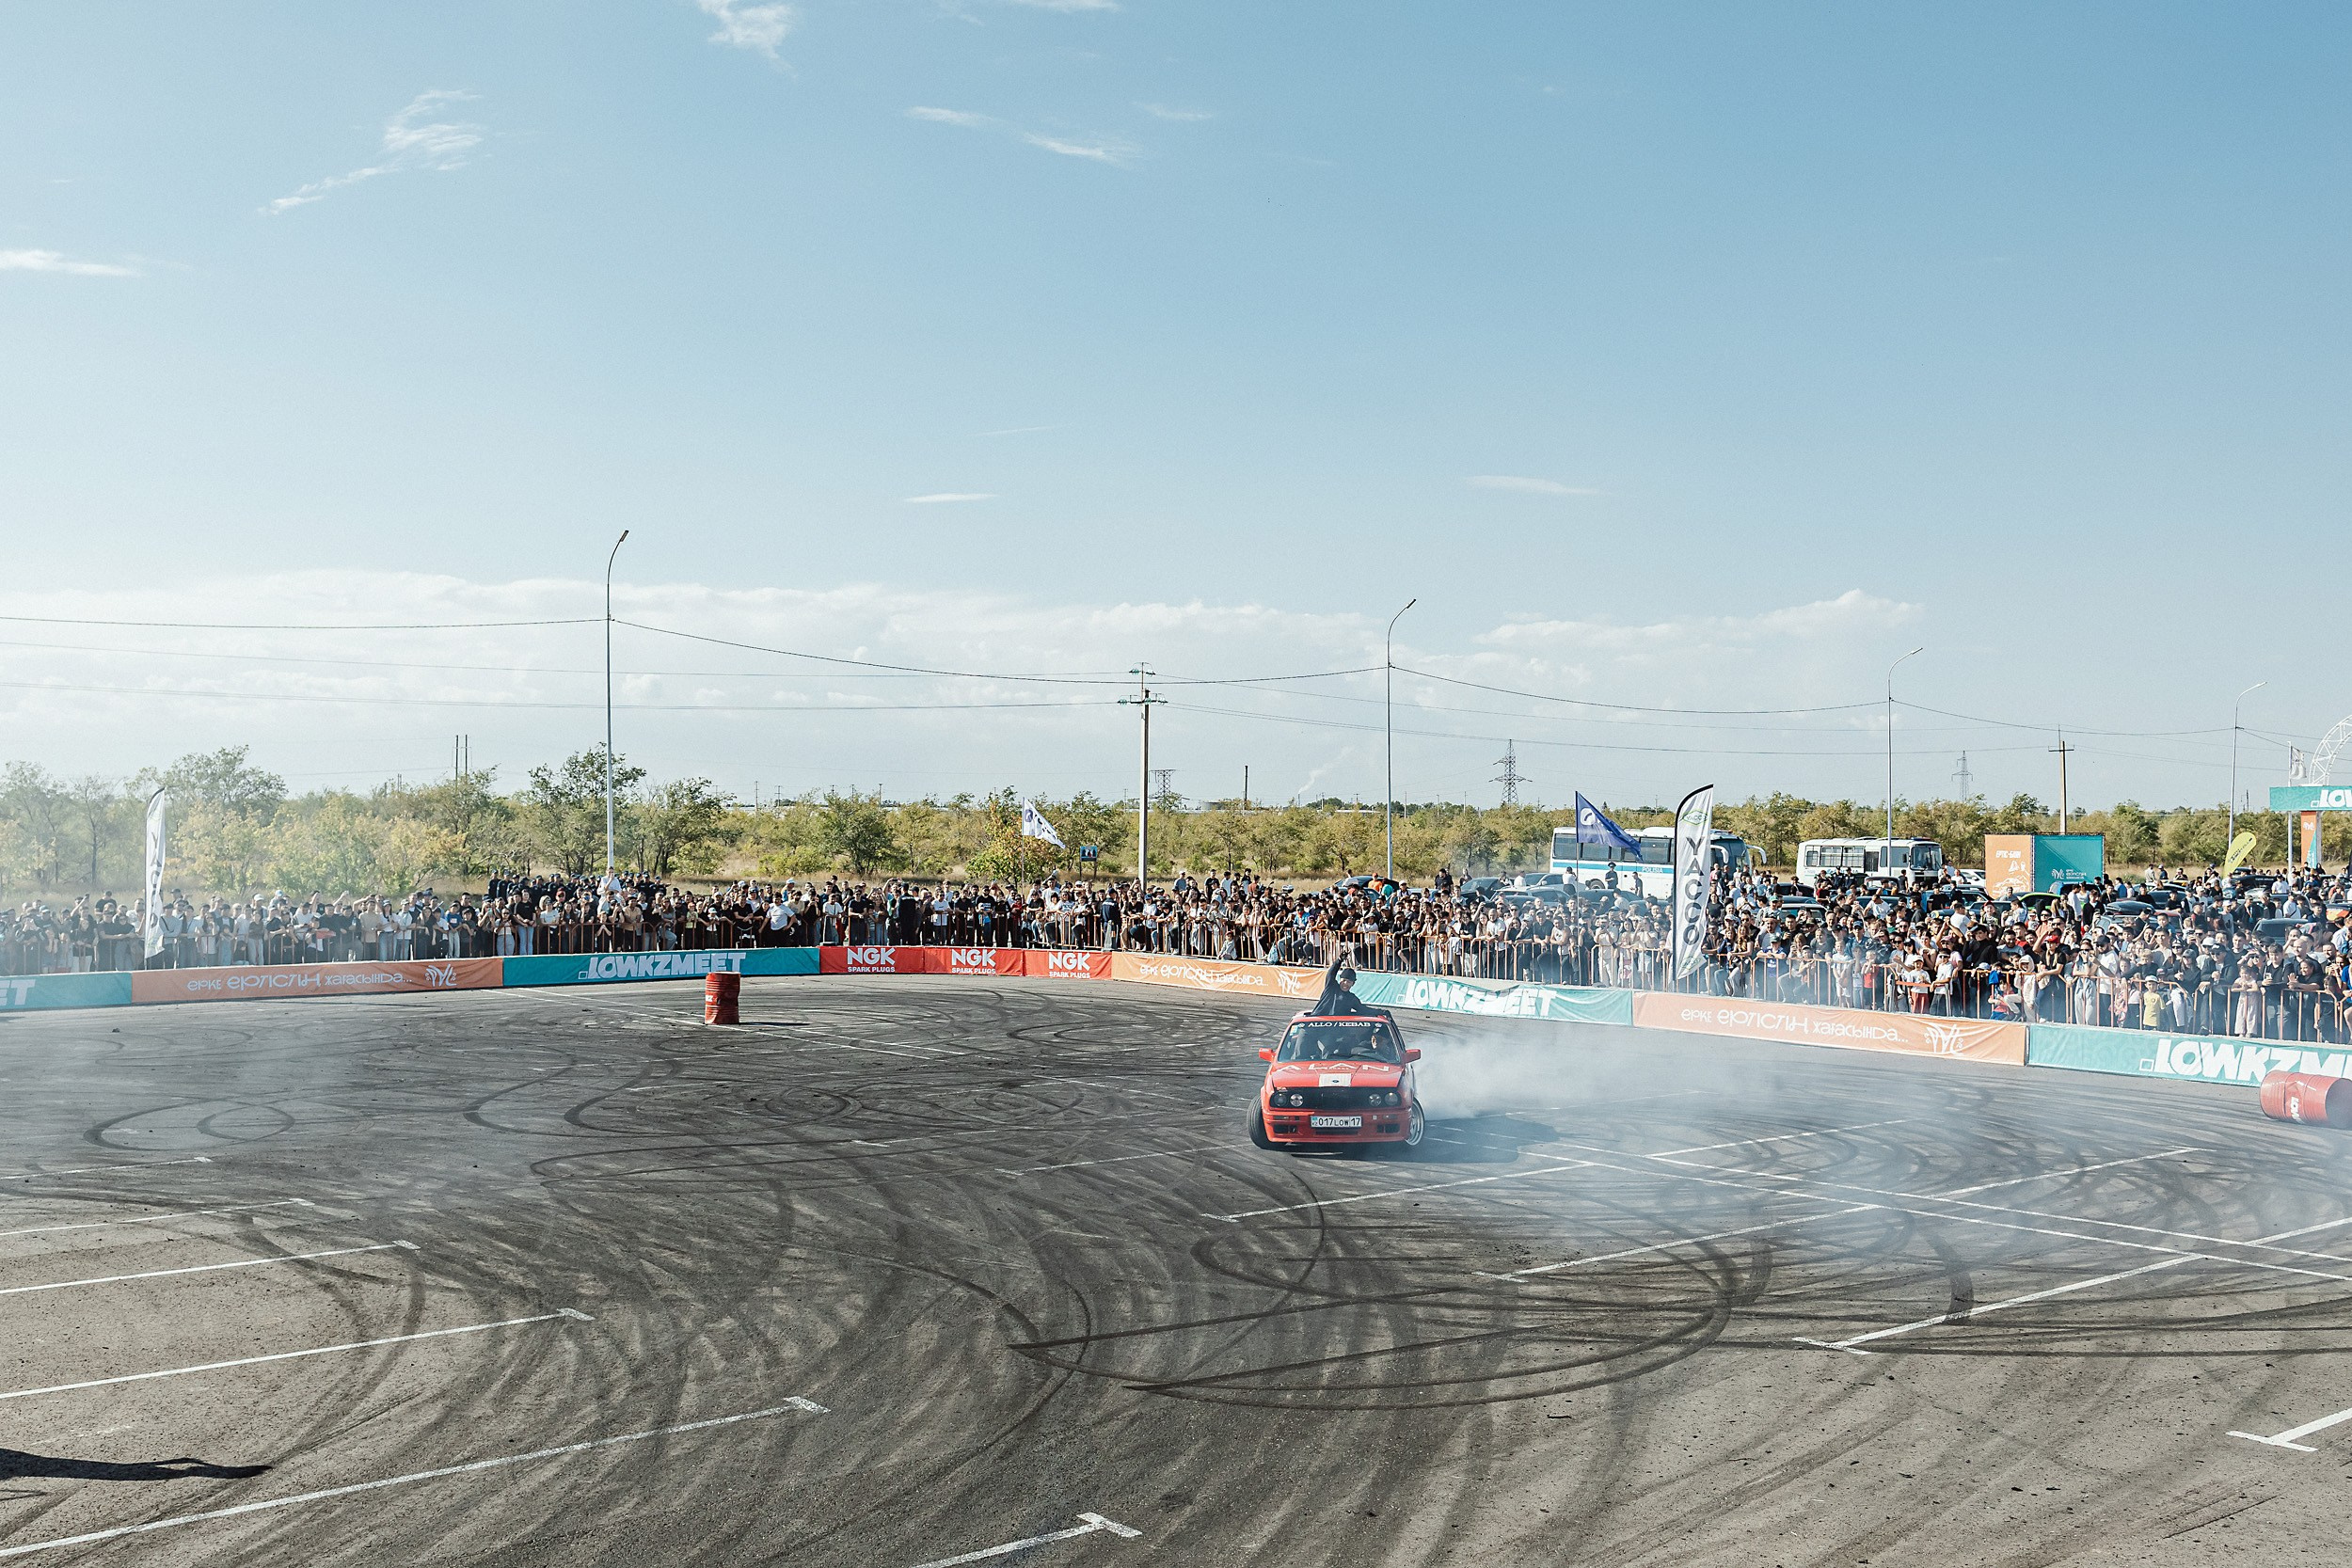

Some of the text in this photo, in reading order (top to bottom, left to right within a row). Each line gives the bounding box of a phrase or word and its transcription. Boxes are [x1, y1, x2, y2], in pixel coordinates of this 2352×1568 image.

[1683, 836, 1706, 946] YACCO
[588, 952, 746, 979] LOWKZMEET
[847, 947, 896, 966] NGK
[951, 948, 997, 967] NGK
[1049, 952, 1091, 971] NGK
[2154, 1038, 2352, 1081] LOWKZM
[1351, 1117, 1361, 1126] 17
